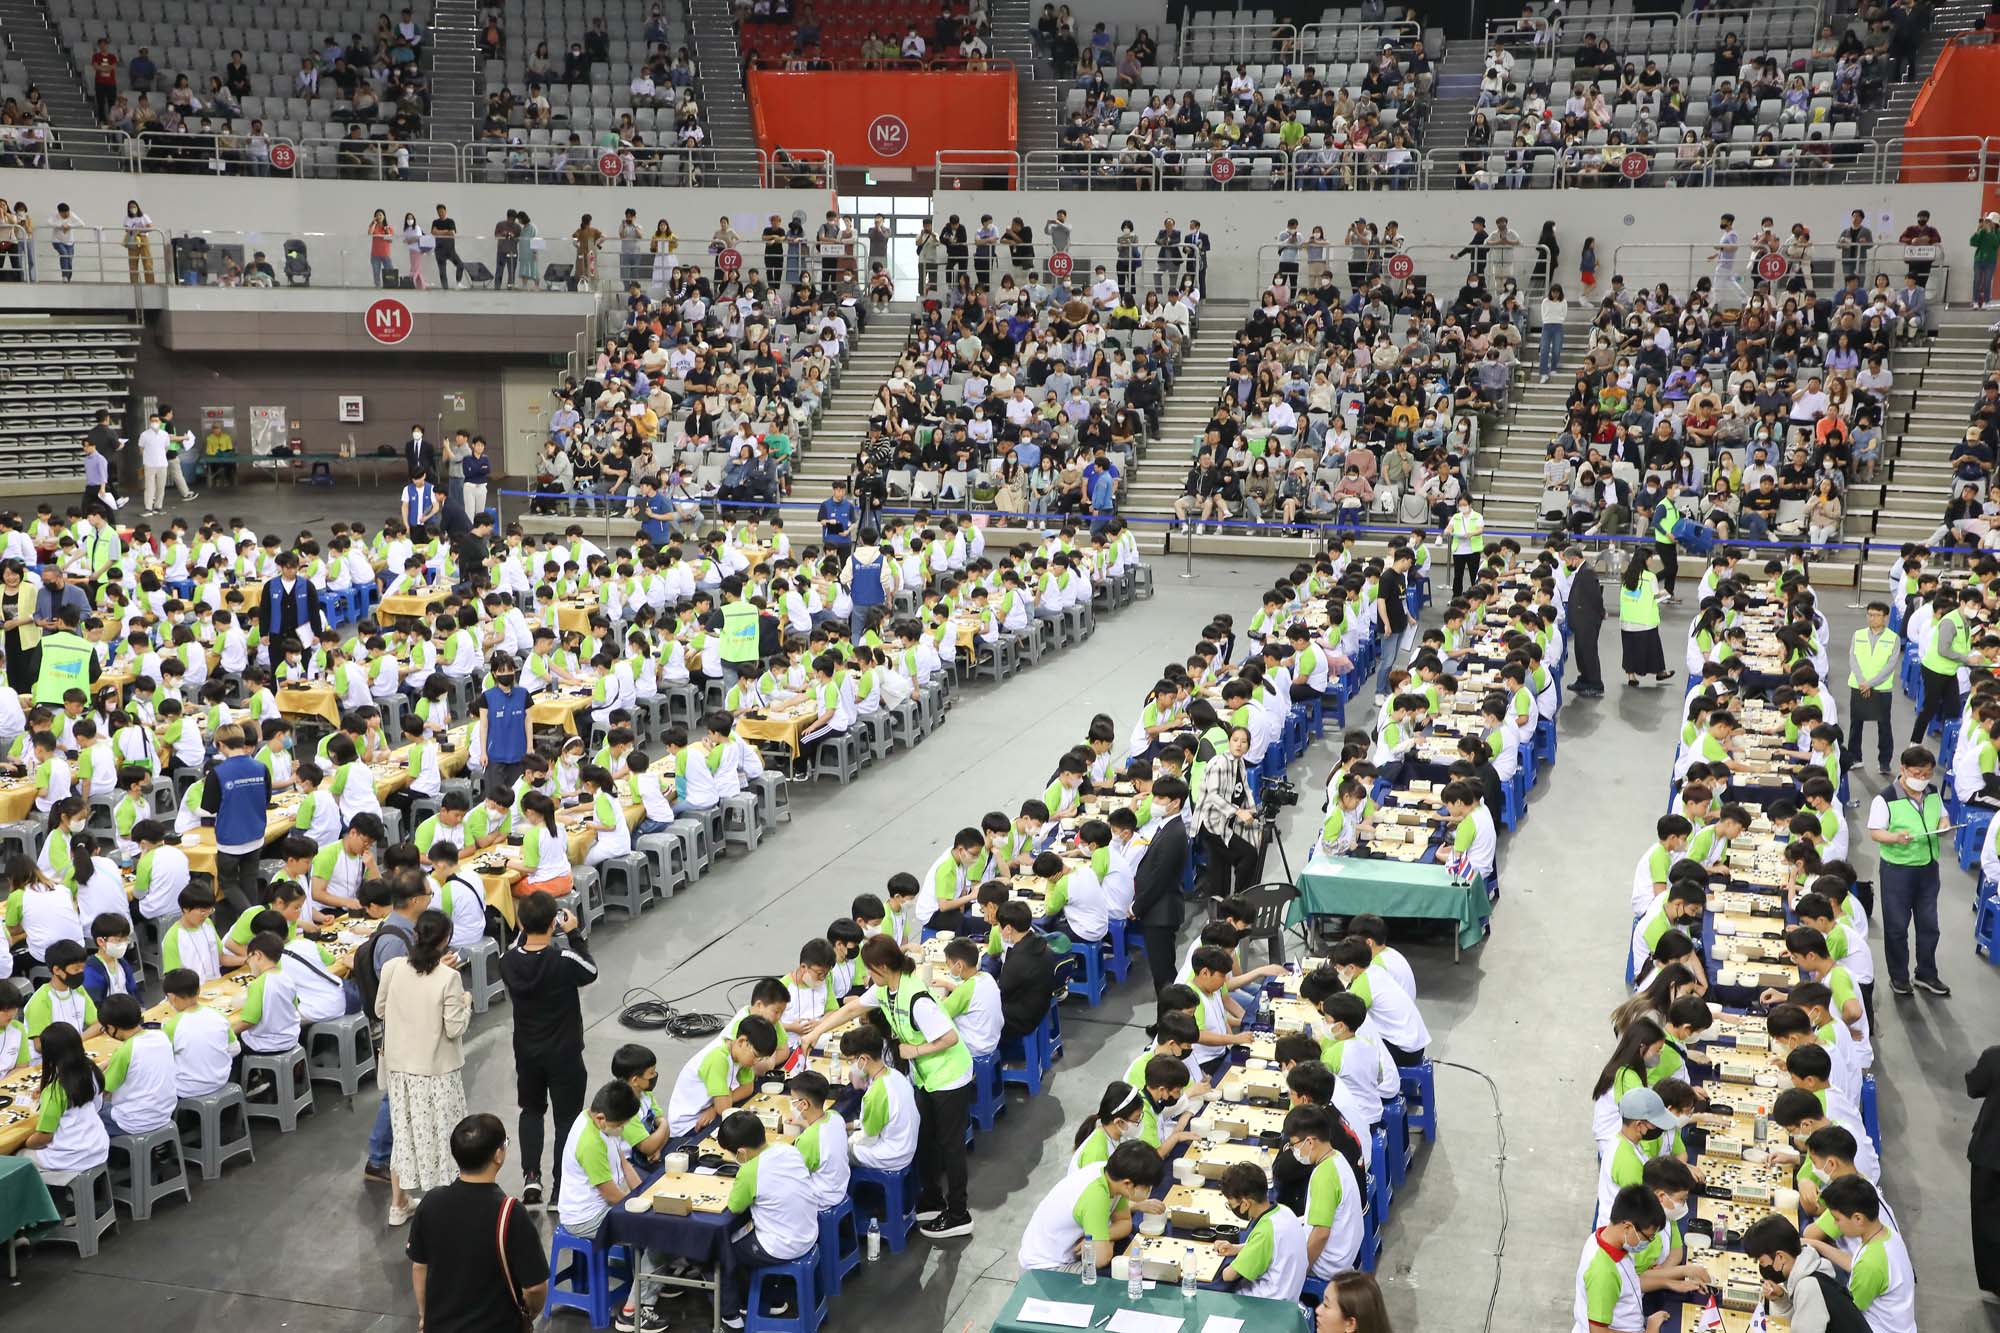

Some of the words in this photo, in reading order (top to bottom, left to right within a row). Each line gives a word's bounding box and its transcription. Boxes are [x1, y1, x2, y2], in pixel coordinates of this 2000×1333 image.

[876, 125, 901, 141] N2
[277, 151, 290, 160] 33
[604, 160, 616, 169] 34
[1217, 164, 1229, 174] 36
[1628, 160, 1641, 170] 37
[724, 256, 736, 265] 07
[1054, 259, 1067, 269] 08
[1394, 261, 1408, 271] 09
[1766, 260, 1780, 272] 10
[376, 308, 401, 327] N1
